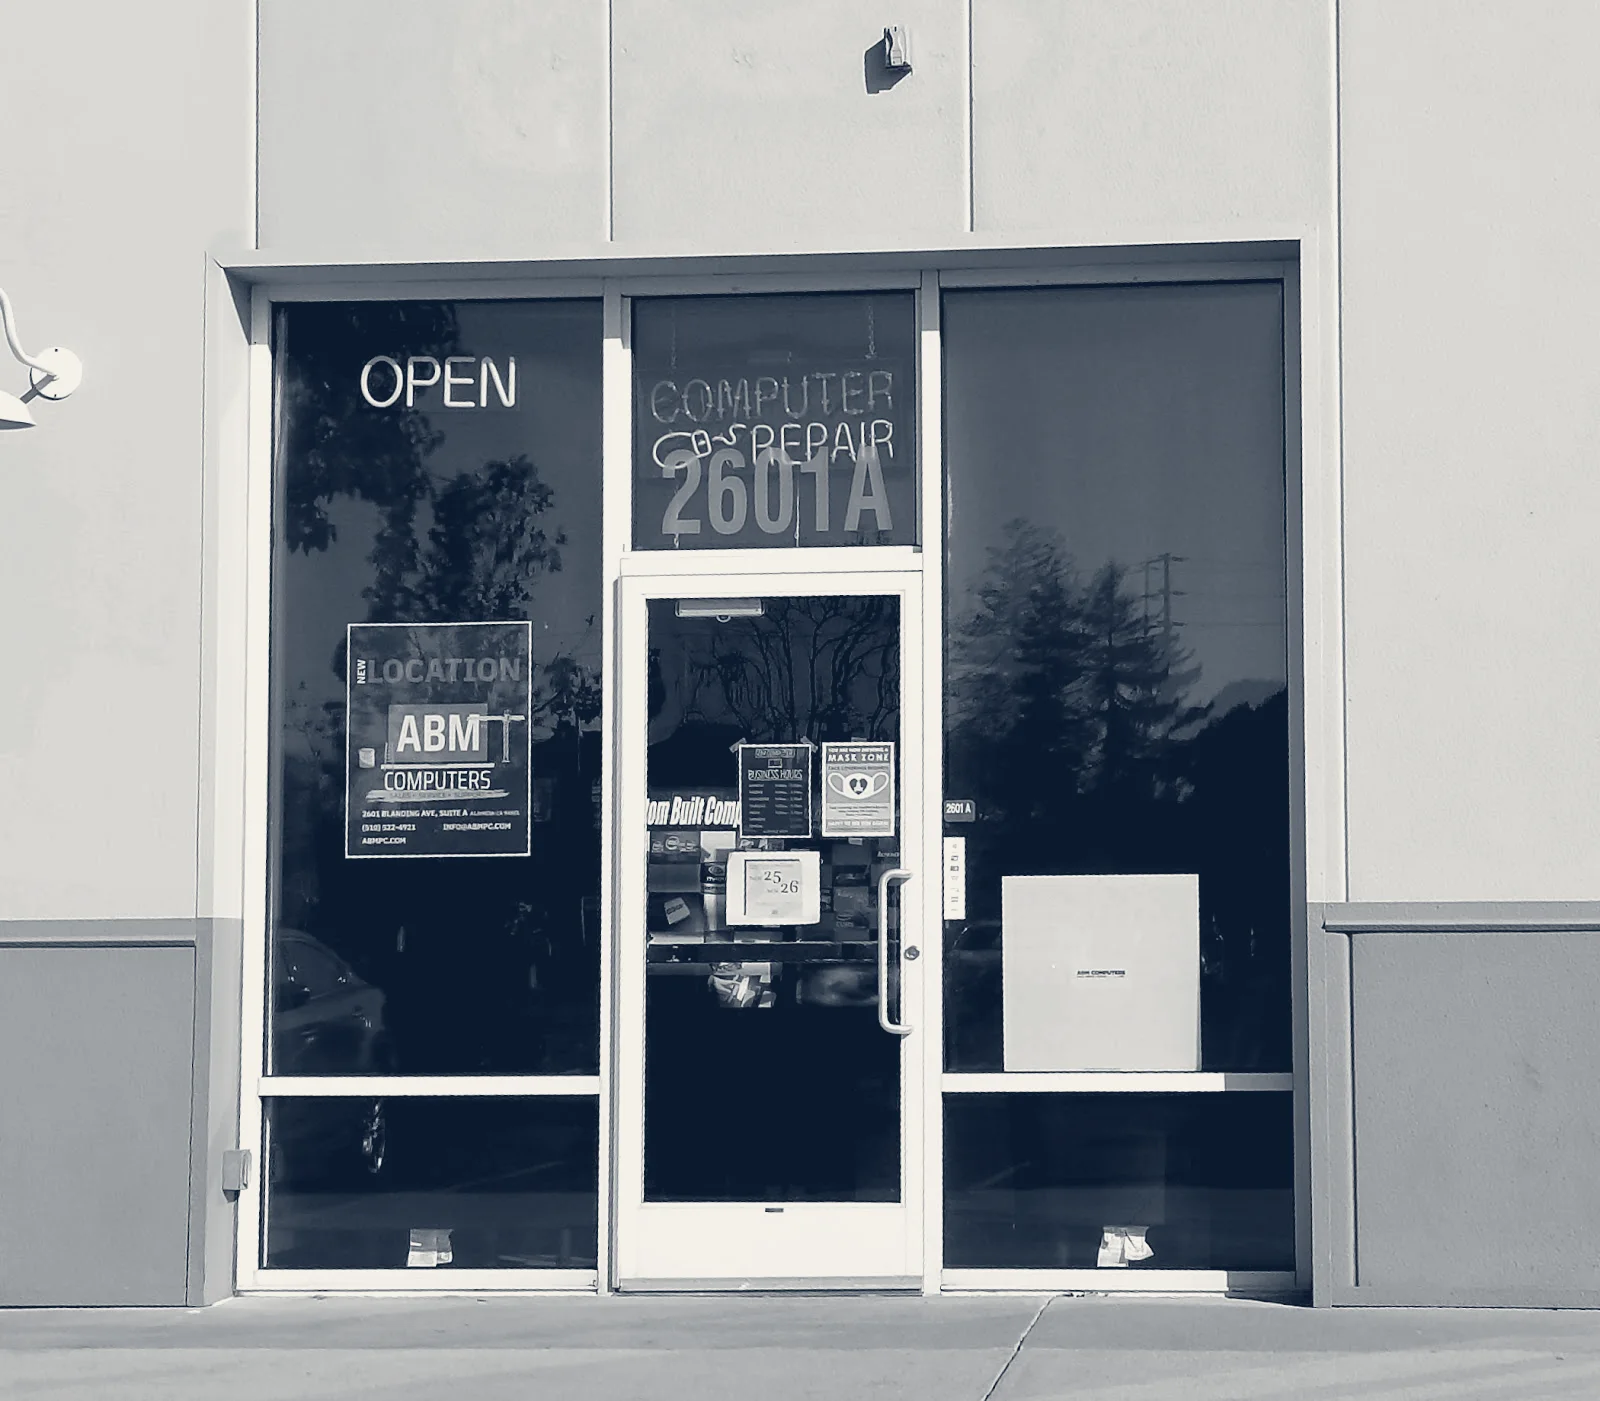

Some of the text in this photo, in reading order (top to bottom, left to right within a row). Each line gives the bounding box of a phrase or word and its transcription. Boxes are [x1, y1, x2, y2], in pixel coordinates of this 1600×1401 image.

[360, 355, 515, 408] OPEN
[650, 370, 893, 424] COMPUTER
[751, 419, 894, 465] REPAIR
[662, 446, 893, 535] 2601A
[356, 659, 366, 684] NEW
[368, 657, 521, 684] LOCATION
[396, 714, 480, 753] ABM
[828, 753, 889, 762] MASK ZONE
[384, 770, 491, 791] COMPUTERS
[362, 810, 380, 818] 2601
[381, 810, 420, 818] BLANDING
[421, 810, 438, 818] AVE,
[647, 798, 670, 825] om
[670, 796, 705, 825] Built
[946, 803, 971, 814] 2601 A
[764, 871, 782, 884] 25
[780, 880, 799, 894] 26
